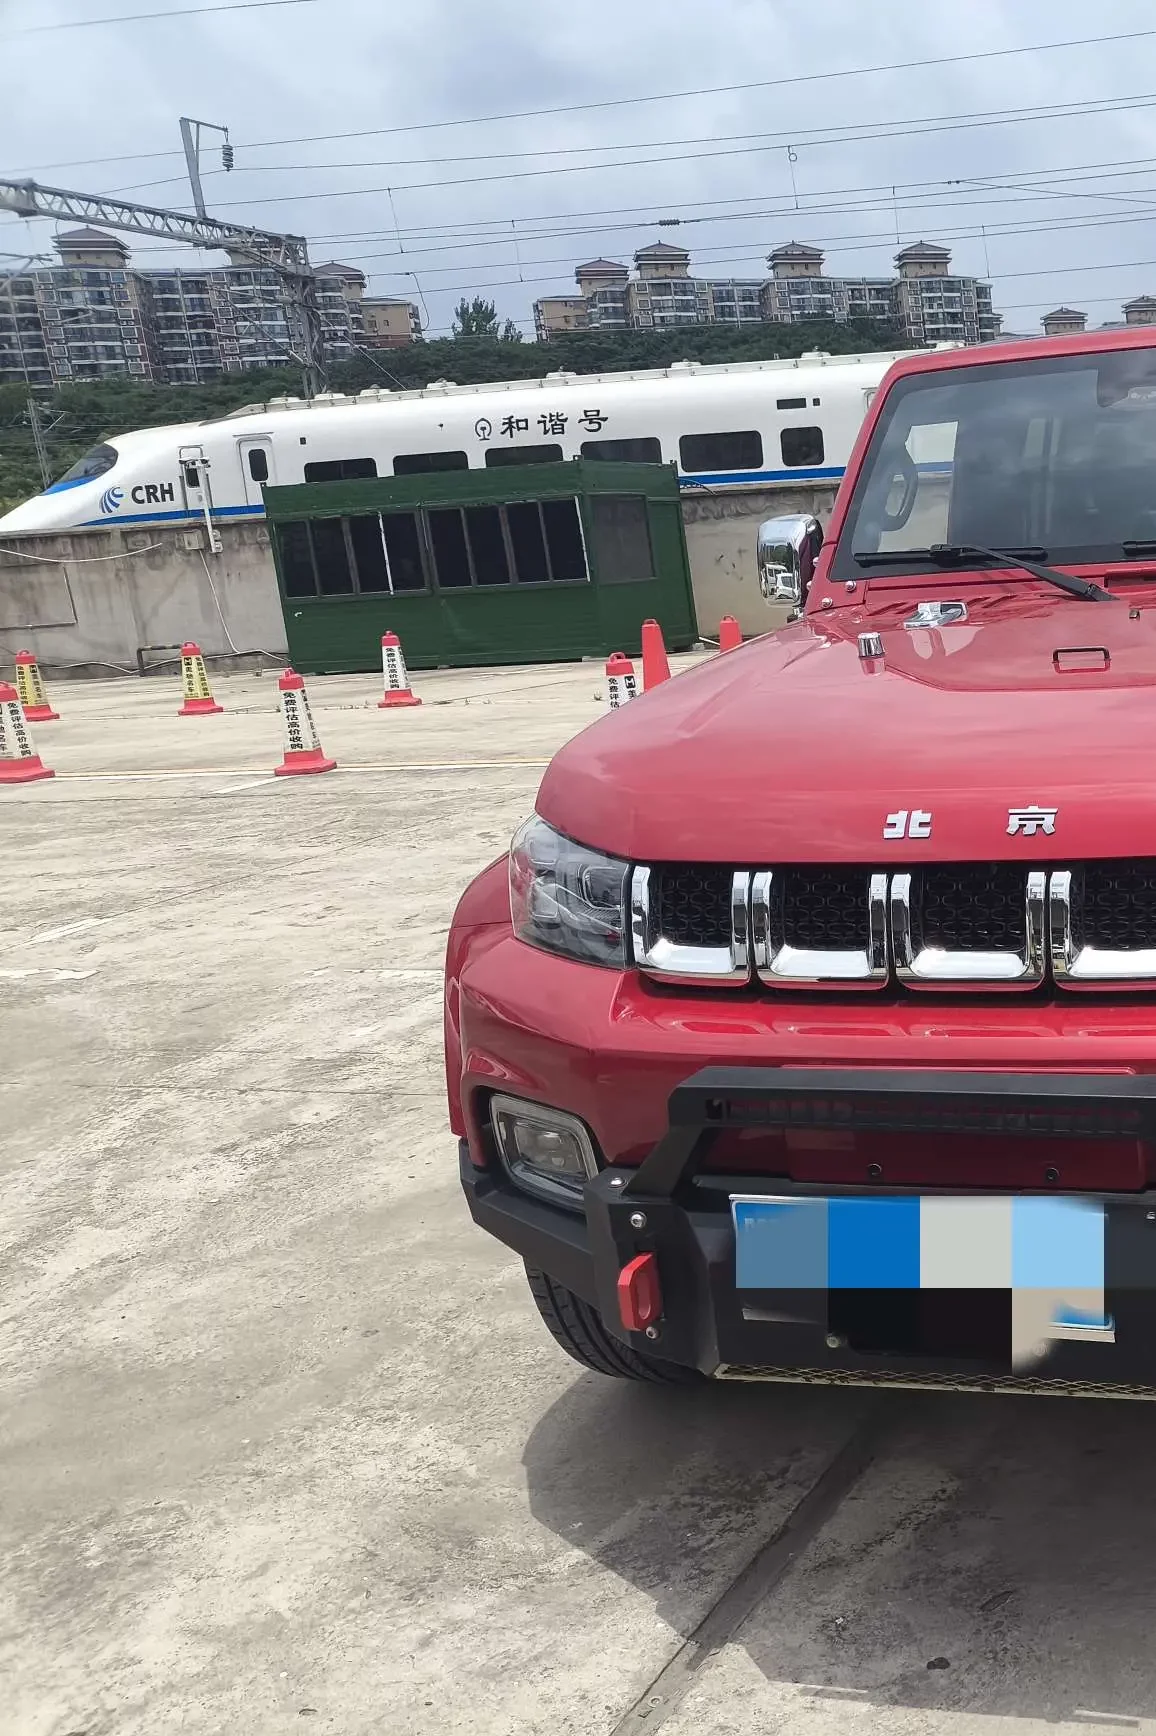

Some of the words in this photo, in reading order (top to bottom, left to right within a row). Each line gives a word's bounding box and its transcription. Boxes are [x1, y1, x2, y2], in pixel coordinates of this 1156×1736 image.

[500, 409, 609, 437] 和谐号
[131, 482, 175, 505] CRH
[608, 677, 620, 711] 免费评估
[7, 702, 32, 756] 免费评估高价收购
[283, 692, 303, 750] 免费评估高价收购
[883, 805, 1059, 839] 北京
